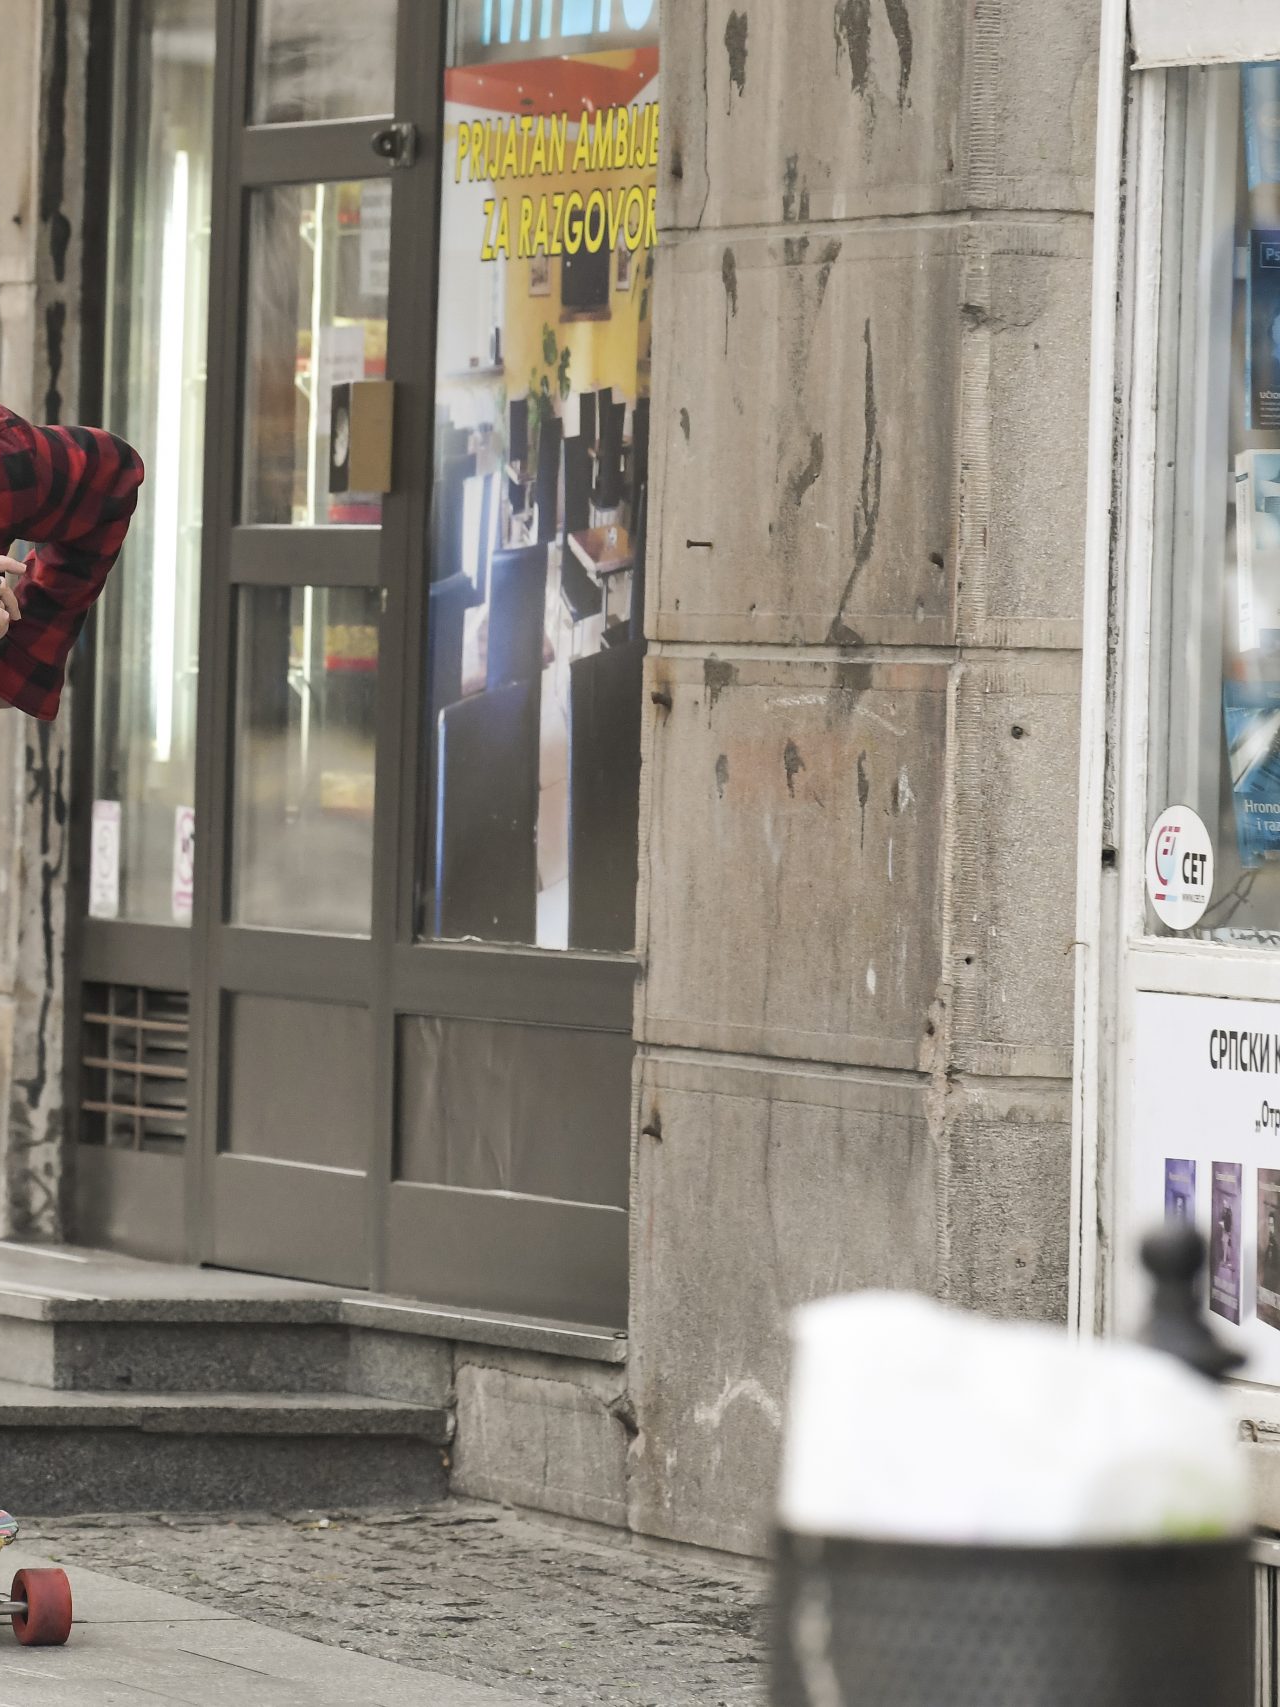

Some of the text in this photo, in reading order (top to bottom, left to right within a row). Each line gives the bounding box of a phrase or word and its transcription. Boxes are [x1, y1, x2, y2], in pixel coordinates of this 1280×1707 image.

[455, 101, 659, 183] PRIJATAN AMBIJE
[481, 185, 658, 261] ZA RAZGOVOR
[1182, 851, 1207, 885] CET
[1209, 1029, 1270, 1074] СРПСКИ
